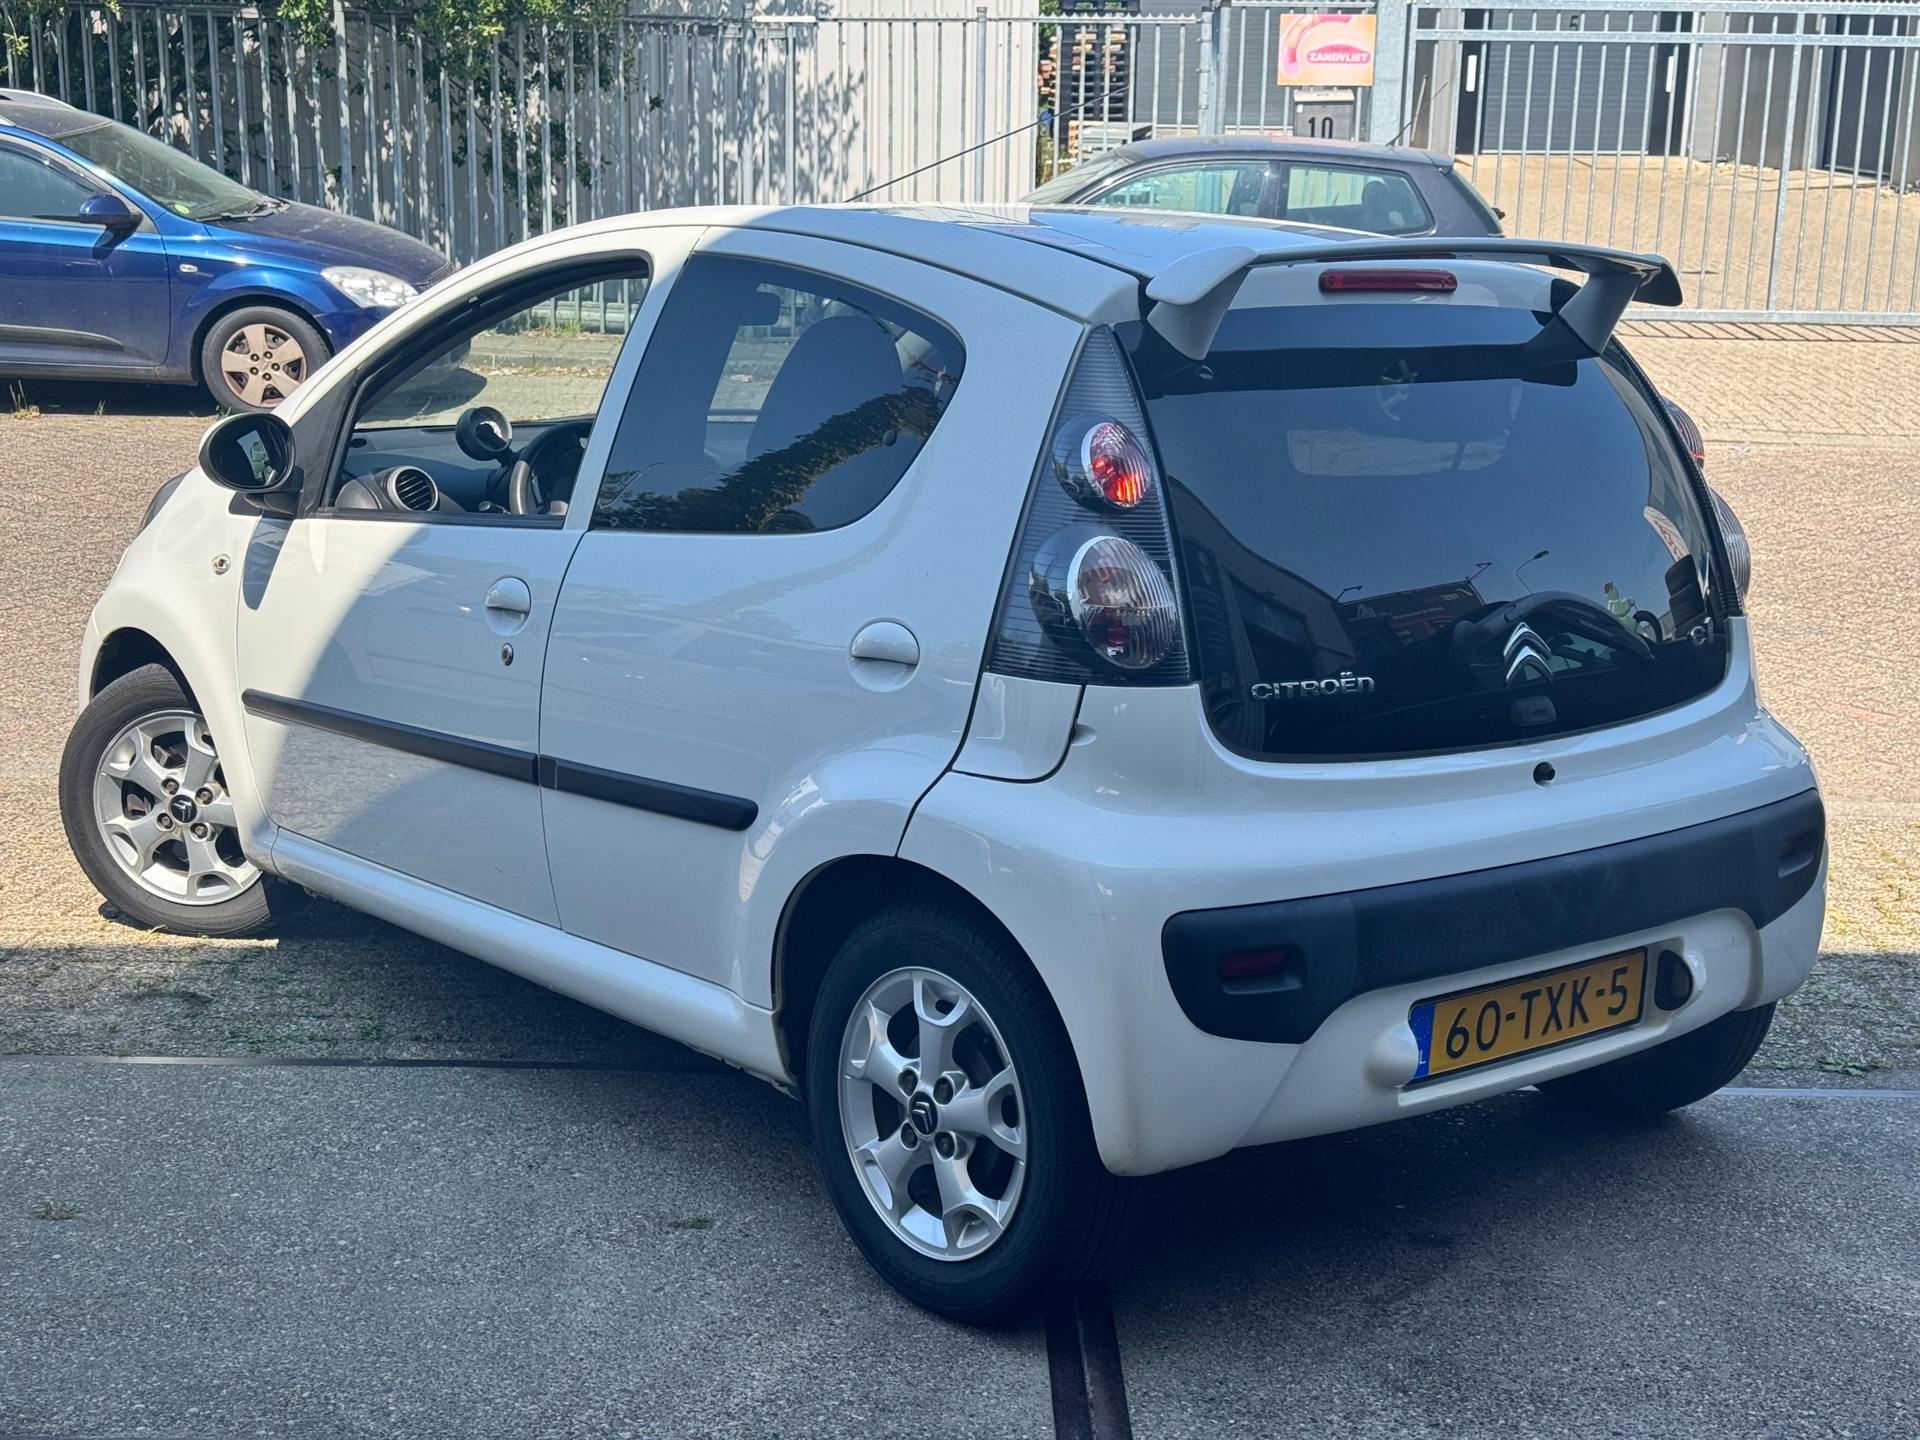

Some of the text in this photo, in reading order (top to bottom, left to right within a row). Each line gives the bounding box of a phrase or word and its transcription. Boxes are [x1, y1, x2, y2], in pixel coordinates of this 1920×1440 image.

[1569, 15, 1580, 31] 5
[1308, 117, 1334, 139] 10
[1445, 965, 1630, 1059] 60-TXK-5
